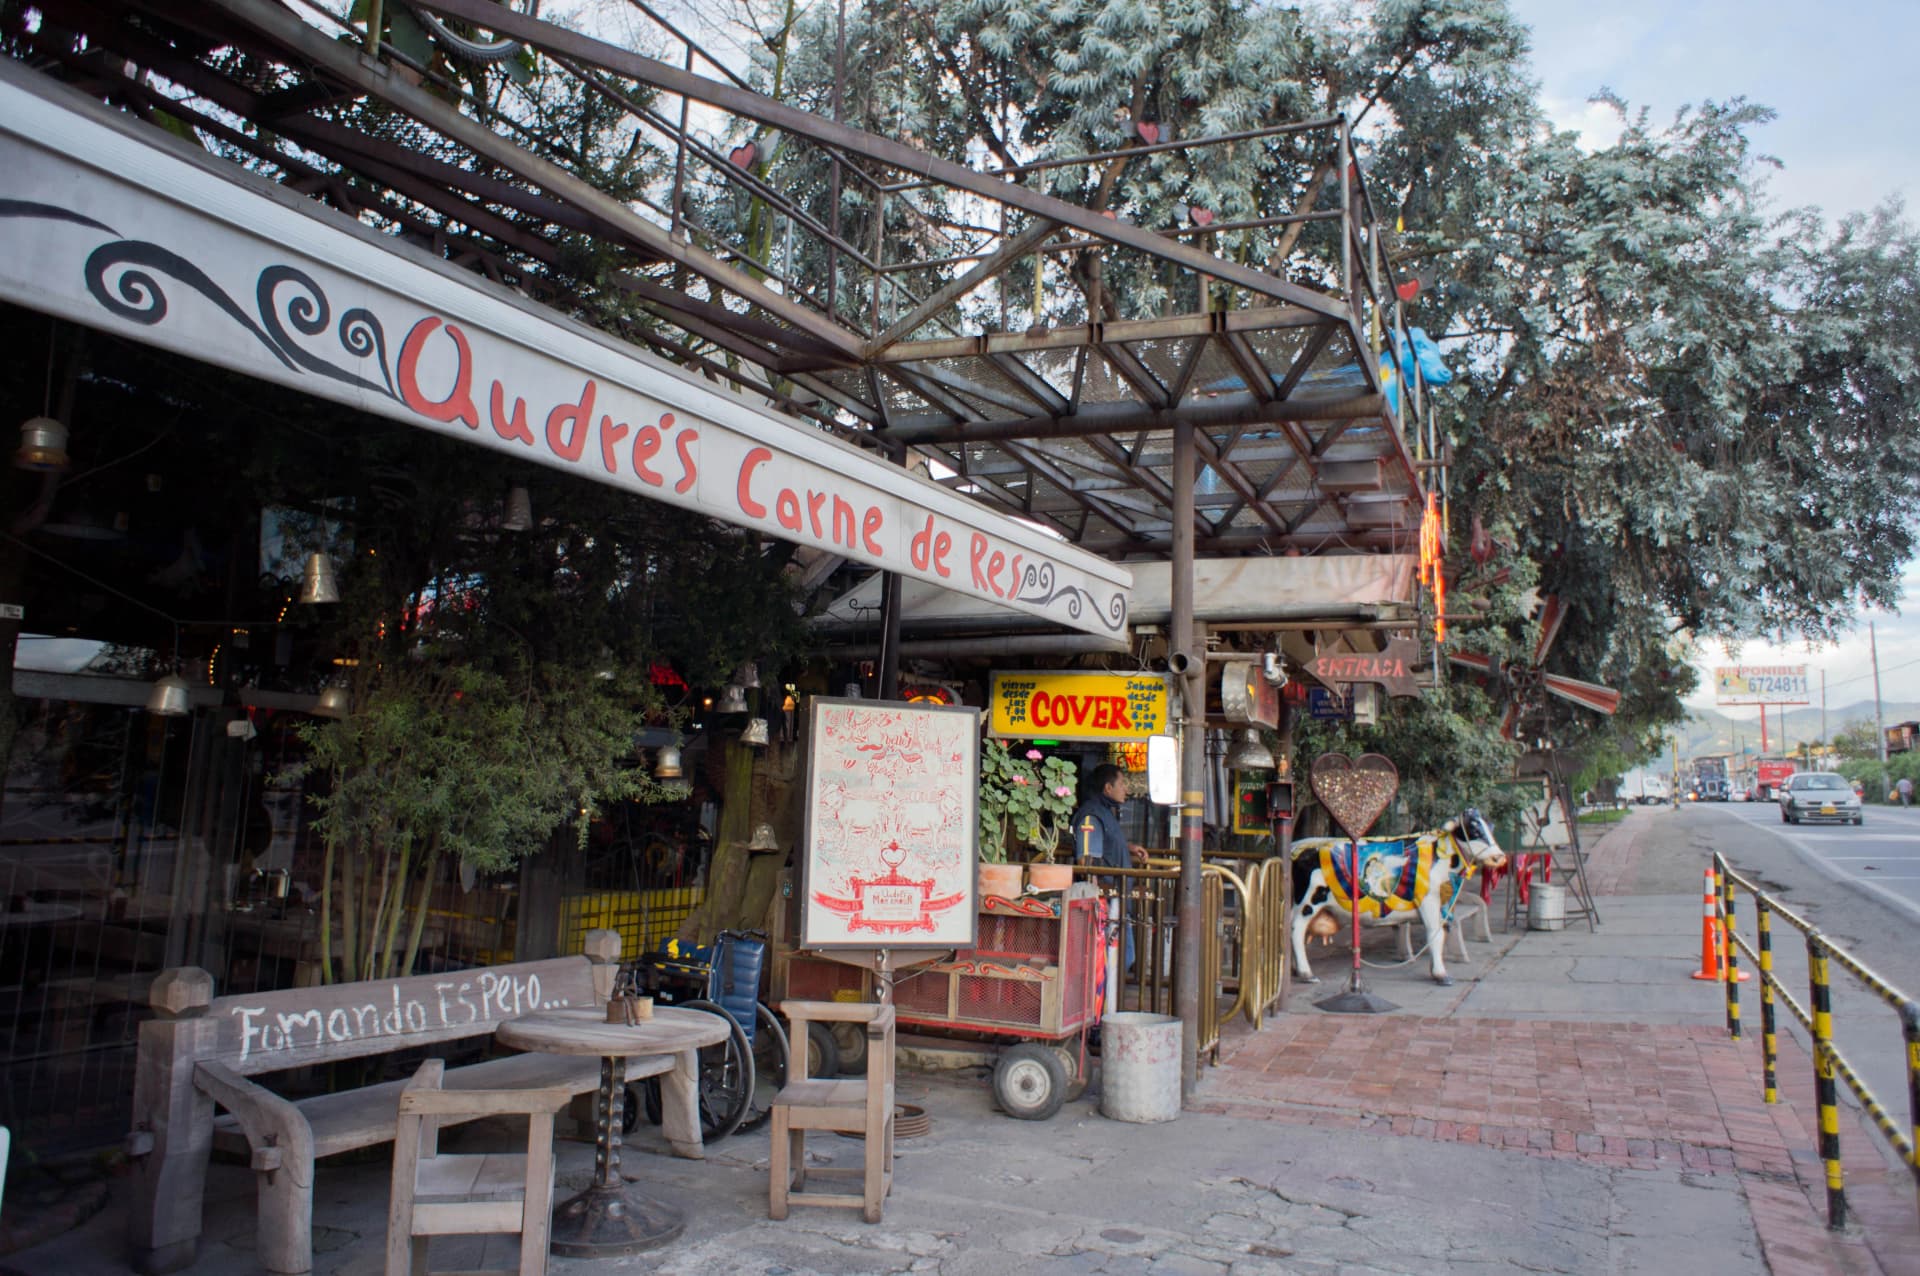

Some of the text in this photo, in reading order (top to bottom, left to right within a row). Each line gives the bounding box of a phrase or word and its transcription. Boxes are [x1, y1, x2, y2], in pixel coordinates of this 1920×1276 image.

[737, 447, 883, 557] Carne
[910, 514, 952, 578] de
[970, 532, 1024, 600] Res
[1316, 657, 1405, 677] ENTRADA
[1748, 676, 1808, 693] 6724811
[1031, 691, 1132, 730] COVER
